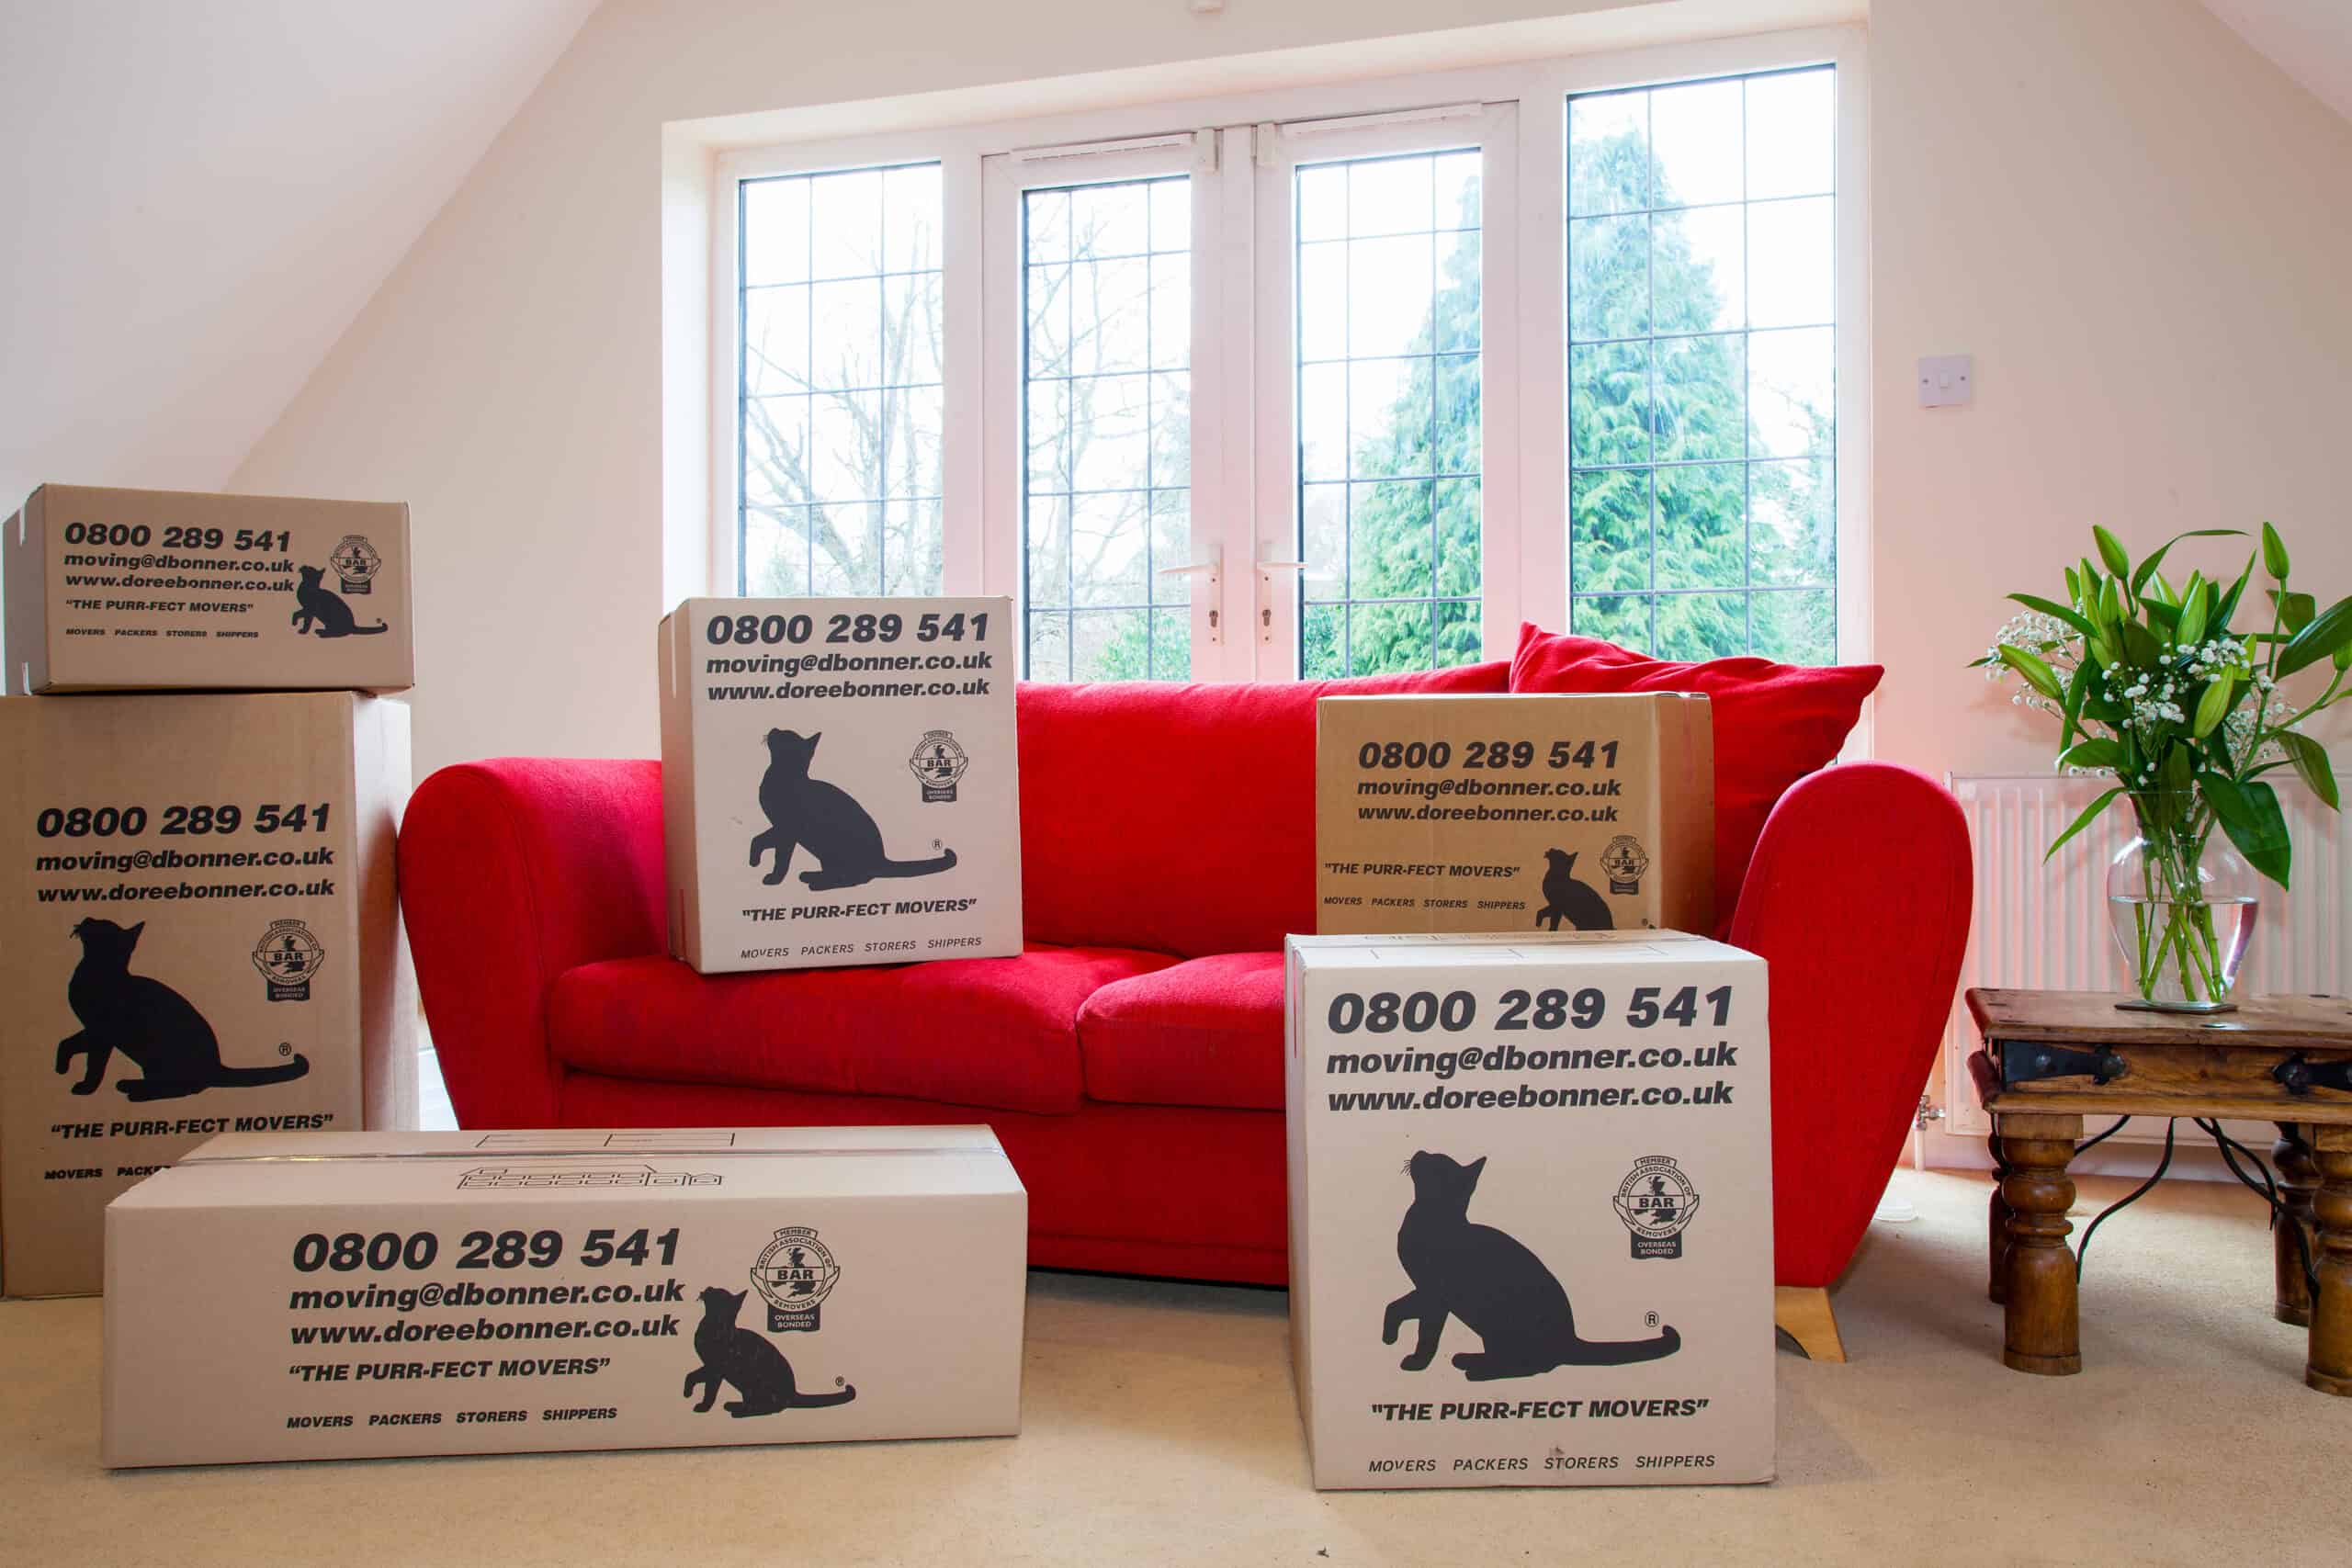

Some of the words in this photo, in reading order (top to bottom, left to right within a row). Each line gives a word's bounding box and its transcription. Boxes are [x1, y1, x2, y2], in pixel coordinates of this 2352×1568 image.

[65, 523, 151, 547] 0800
[163, 526, 223, 549] 289
[234, 530, 289, 552] 541
[63, 552, 295, 573] moving@dbonner.co.uk
[65, 573, 294, 592] www.doreebonner.co.uk
[106, 600, 187, 612] PURR-FECT
[707, 615, 812, 645] 0800
[826, 615, 902, 643] 289
[917, 614, 988, 642] 541
[707, 651, 992, 677] moving@dbonner.co.uk
[708, 678, 989, 700] www.doreebonner.co.uk
[1359, 742, 1451, 769] 0800
[1463, 741, 1533, 768] 289
[1548, 741, 1618, 769] 541
[1358, 779, 1621, 800] moving@dbonner.co.uk
[38, 807, 147, 838] 0800
[160, 806, 241, 835] 289
[254, 804, 329, 833] 541
[1358, 804, 1618, 822] www.doreebonner.co.uk
[37, 847, 334, 873] moving@dbonner.co.uk
[1363, 863, 1446, 876] PURR-FECT
[38, 879, 334, 902] www.doreebonner.co.uk
[790, 903, 892, 919] PURR-FECT
[1323, 896, 1363, 906] MOVERS
[1371, 897, 1415, 908] PACKERS
[1423, 898, 1468, 908] STORERS
[1476, 900, 1526, 910] SHIPPERS
[273, 952, 303, 961] BAR
[741, 947, 789, 959] MOVERS
[800, 943, 854, 956] PACKERS
[864, 940, 917, 953] STORERS
[927, 937, 982, 949] SHIPPERS
[1329, 991, 1476, 1033] 0800
[1495, 988, 1605, 1030] 289
[1627, 986, 1732, 1028] 541
[1327, 1042, 1737, 1079] moving@dbonner.co.uk
[1329, 1081, 1734, 1111] www.doreebonner.co.uk
[109, 1118, 231, 1137] PURR-FECT
[43, 1168, 104, 1180] MOVERS
[1621, 1171, 1640, 1198] BRITISH
[1639, 1166, 1686, 1186] ASSOCIATION
[1684, 1186, 1692, 1196] OF
[1638, 1197, 1674, 1208] BAR
[1636, 1226, 1677, 1237] REMOVERS
[294, 1232, 437, 1272] 0800
[456, 1230, 562, 1269] 289
[581, 1228, 679, 1267] 541
[759, 1244, 779, 1269] BRITISH
[778, 1237, 827, 1258] ASSOCIATION
[823, 1258, 832, 1269] OF
[777, 1269, 814, 1280] BAR
[289, 1279, 685, 1312] moving@dbonner.co.uk
[773, 1299, 816, 1310] REMOVERS
[291, 1316, 680, 1344] www.doreebonner.co.uk
[355, 1360, 493, 1381] PURR-FECT
[286, 1415, 354, 1428] MOVERS
[368, 1412, 442, 1427] PACKERS
[456, 1410, 528, 1424] STORERS
[542, 1407, 617, 1421] SHIPPERS
[1440, 1400, 1584, 1420] PURR-FECT
[1368, 1459, 1437, 1472] MOVERS
[1453, 1457, 1529, 1471] PACKERS
[1544, 1456, 1619, 1470] STORERS
[1635, 1454, 1715, 1469] SHIPPERS
